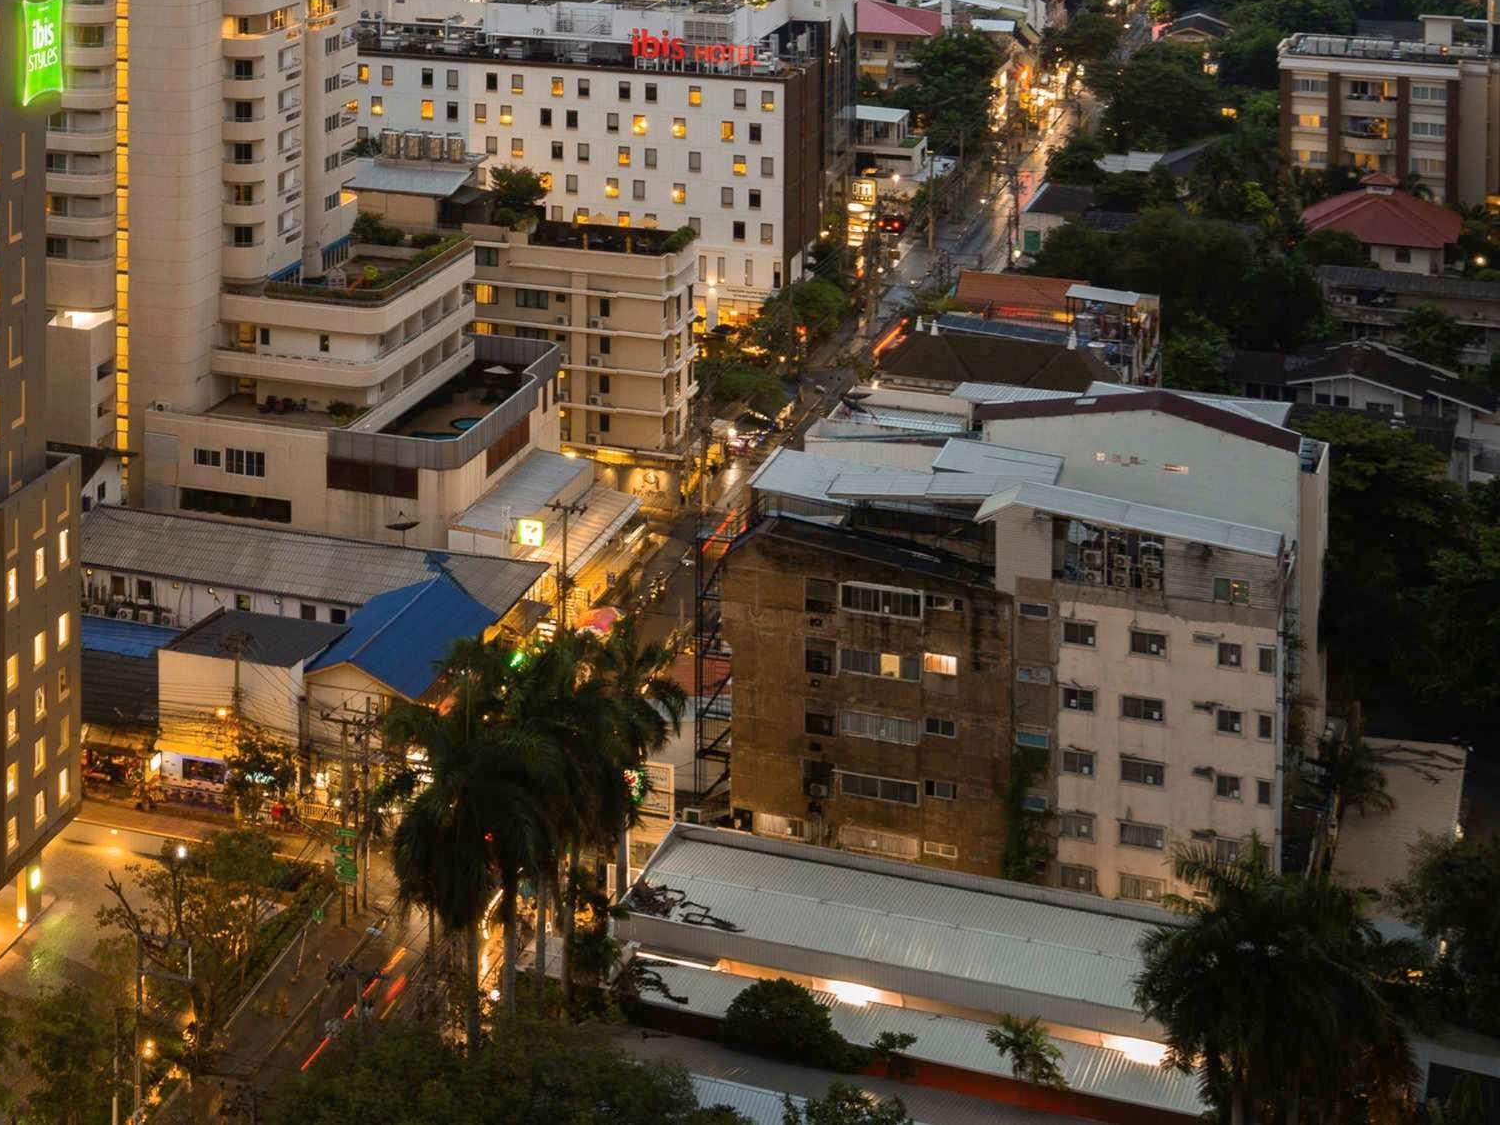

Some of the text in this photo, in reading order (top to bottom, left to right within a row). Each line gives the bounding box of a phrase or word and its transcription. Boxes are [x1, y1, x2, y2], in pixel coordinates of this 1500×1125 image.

[32, 16, 55, 50] ibis
[631, 27, 763, 67] ibis HOTEL
